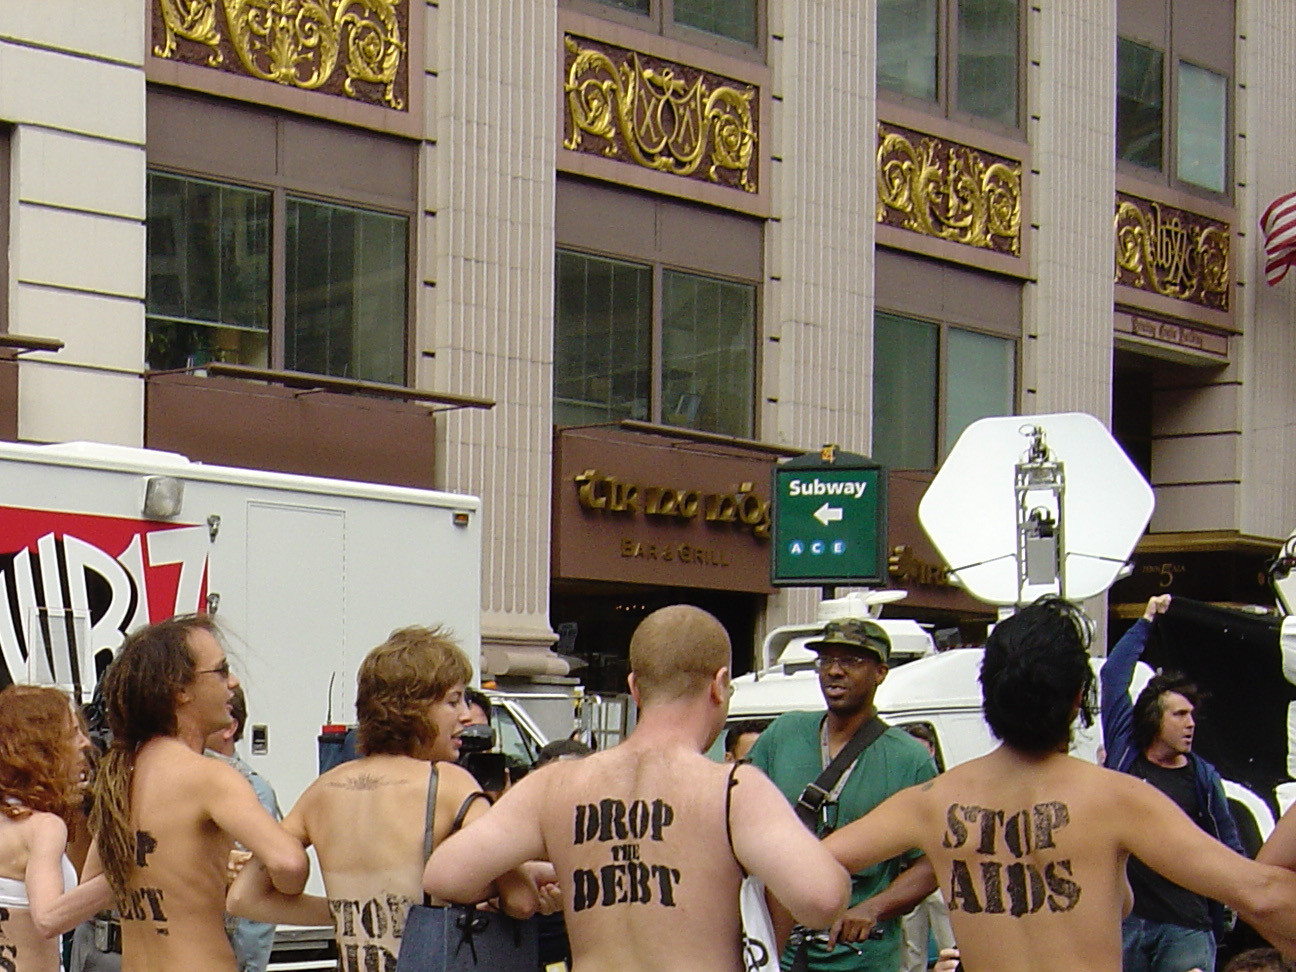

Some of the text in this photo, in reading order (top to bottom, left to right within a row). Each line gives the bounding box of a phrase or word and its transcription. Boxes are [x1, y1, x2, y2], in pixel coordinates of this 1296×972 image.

[789, 479, 867, 498] Subway
[574, 798, 674, 845] DROP
[942, 801, 1070, 858] STOP
[611, 844, 640, 861] THE
[572, 861, 681, 912] DEBT
[948, 859, 1082, 918] AIDS
